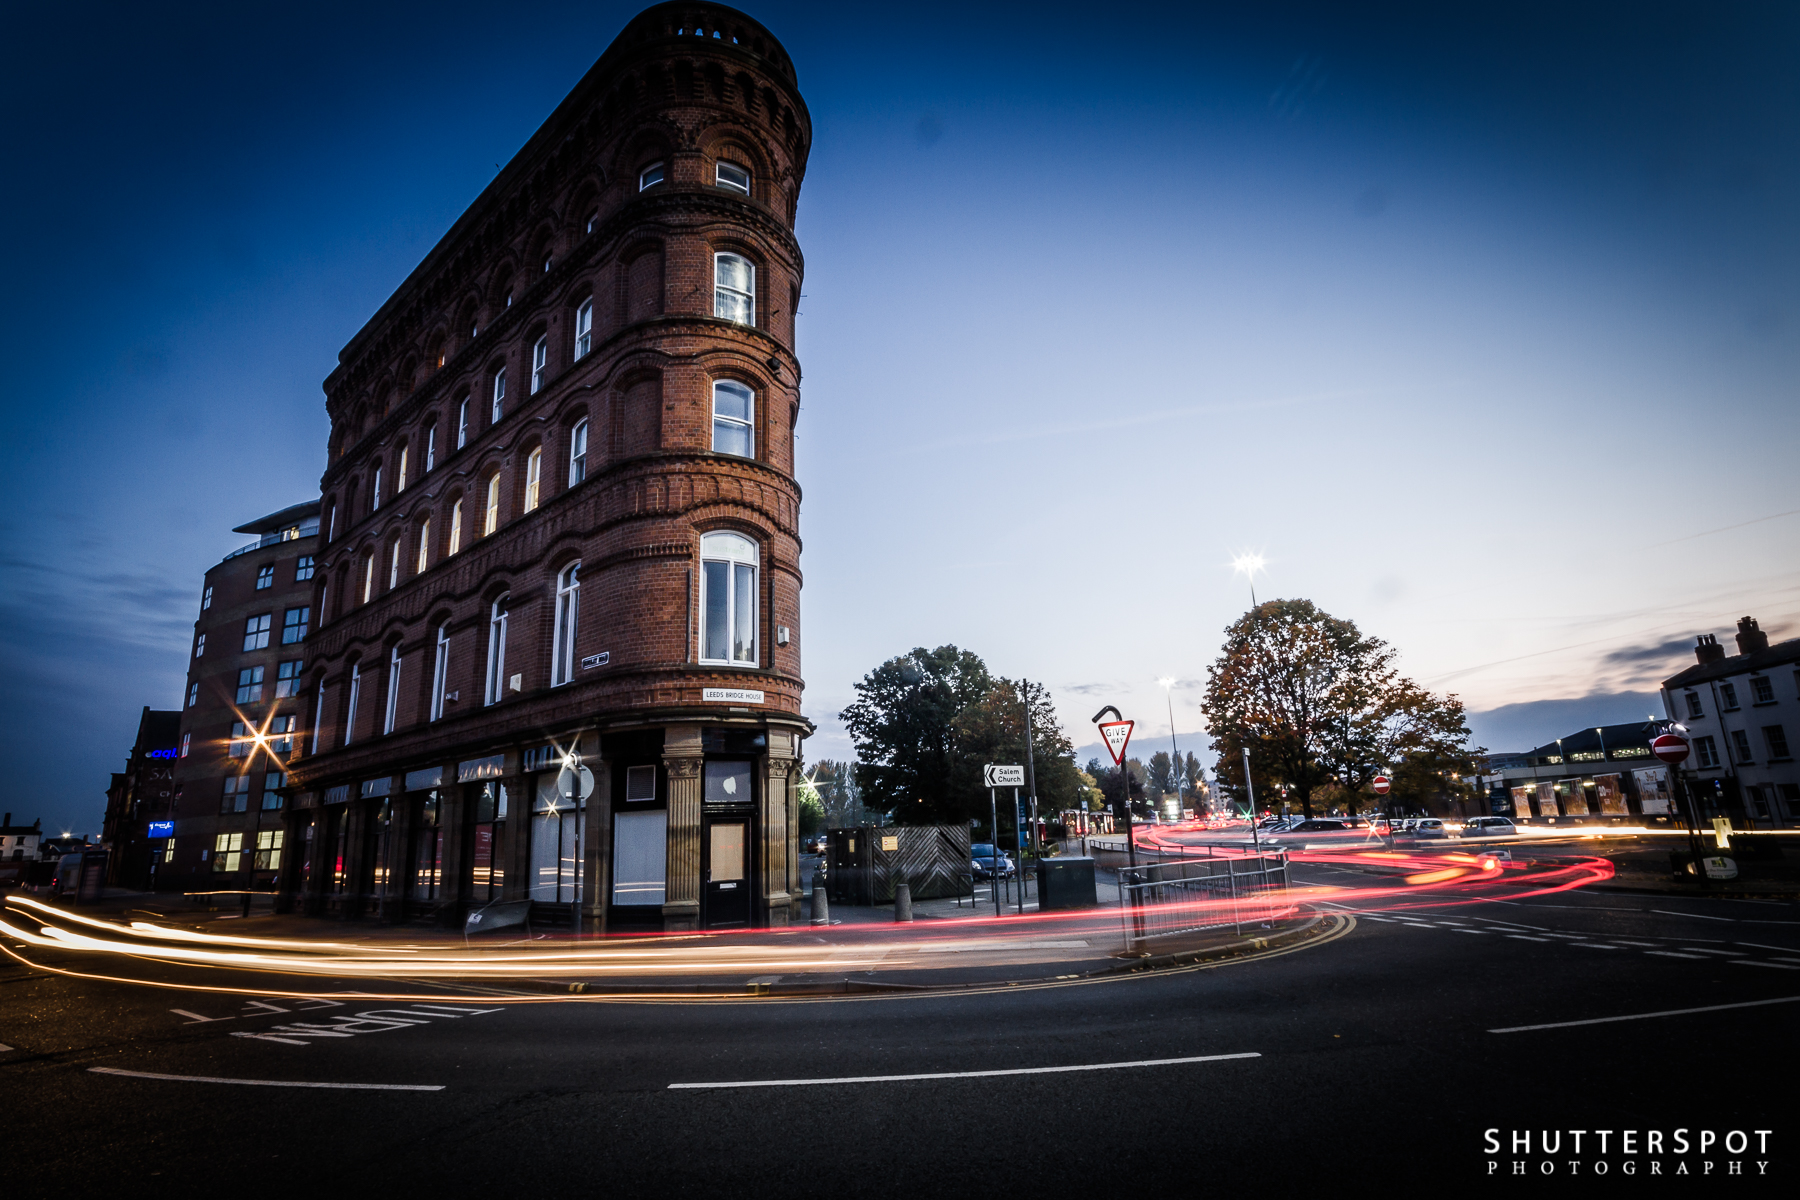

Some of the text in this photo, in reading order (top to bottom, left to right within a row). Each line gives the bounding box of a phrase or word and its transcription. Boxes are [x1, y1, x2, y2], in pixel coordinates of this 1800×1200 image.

[1105, 727, 1126, 737] GIVE
[997, 775, 1021, 783] Church
[229, 1003, 506, 1046] TURN
